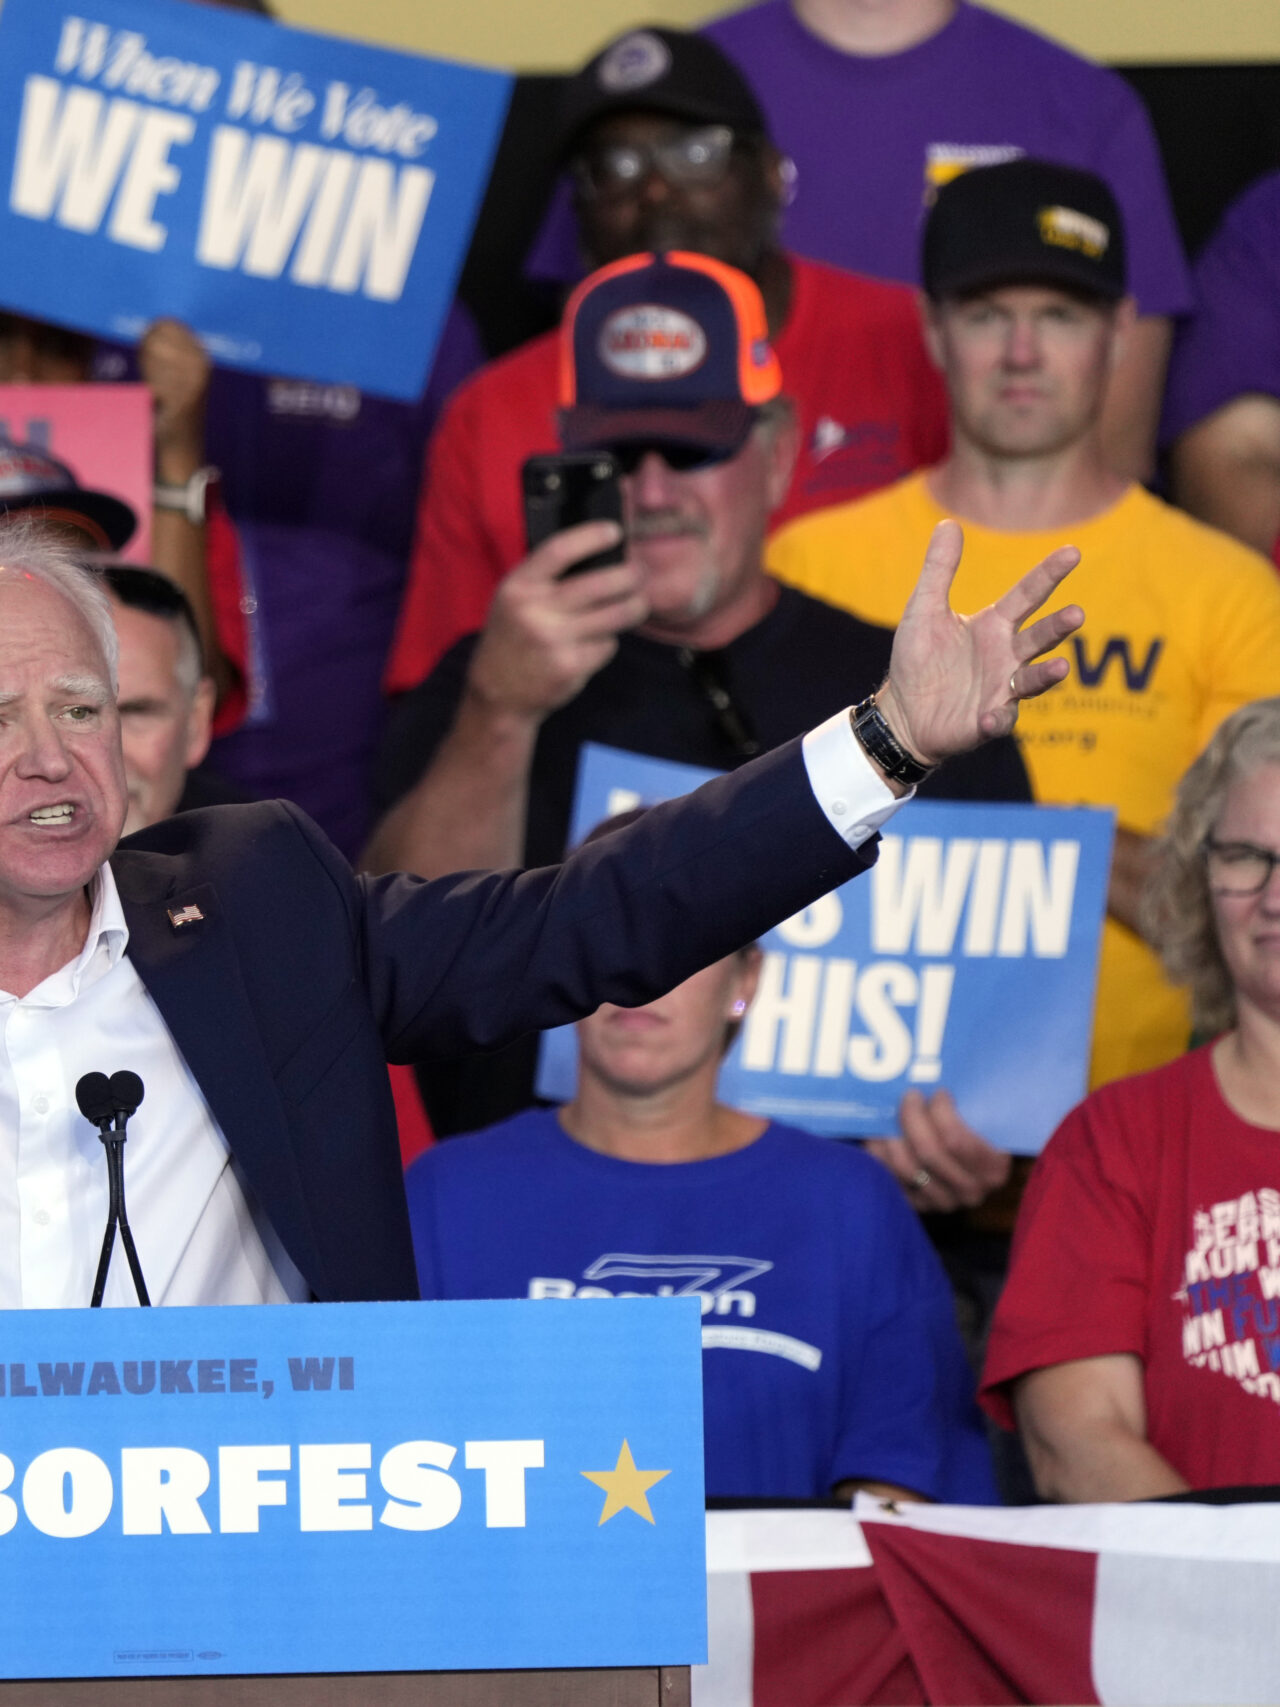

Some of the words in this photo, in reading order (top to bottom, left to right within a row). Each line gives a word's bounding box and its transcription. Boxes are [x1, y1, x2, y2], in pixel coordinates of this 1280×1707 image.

[55, 15, 219, 112] When
[228, 60, 315, 132] We
[321, 82, 438, 158] Vote
[11, 74, 196, 252] WE
[196, 124, 436, 303] WIN
[871, 834, 1081, 959] WIN
[741, 951, 957, 1083] HIS!
[287, 1357, 355, 1391] WI
